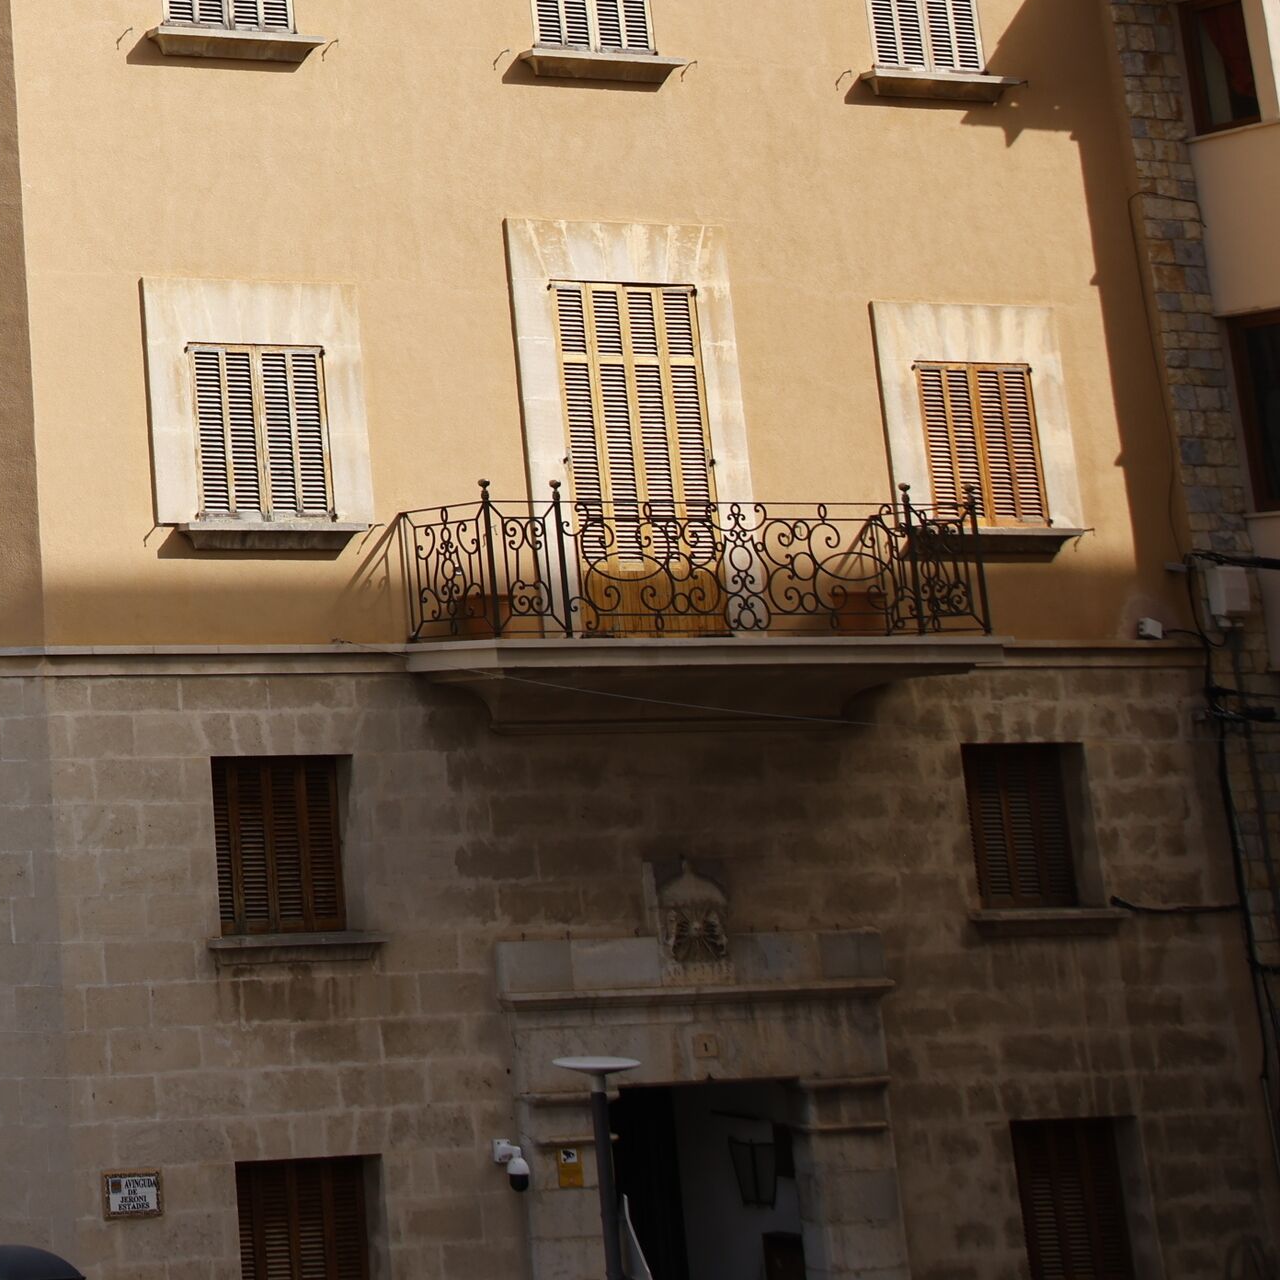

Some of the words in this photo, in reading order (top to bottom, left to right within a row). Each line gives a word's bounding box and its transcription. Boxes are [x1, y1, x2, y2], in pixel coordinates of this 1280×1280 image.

[125, 1178, 157, 1189] AVINGUDA
[120, 1195, 146, 1203] JERONI
[119, 1202, 150, 1210] ESTADES
